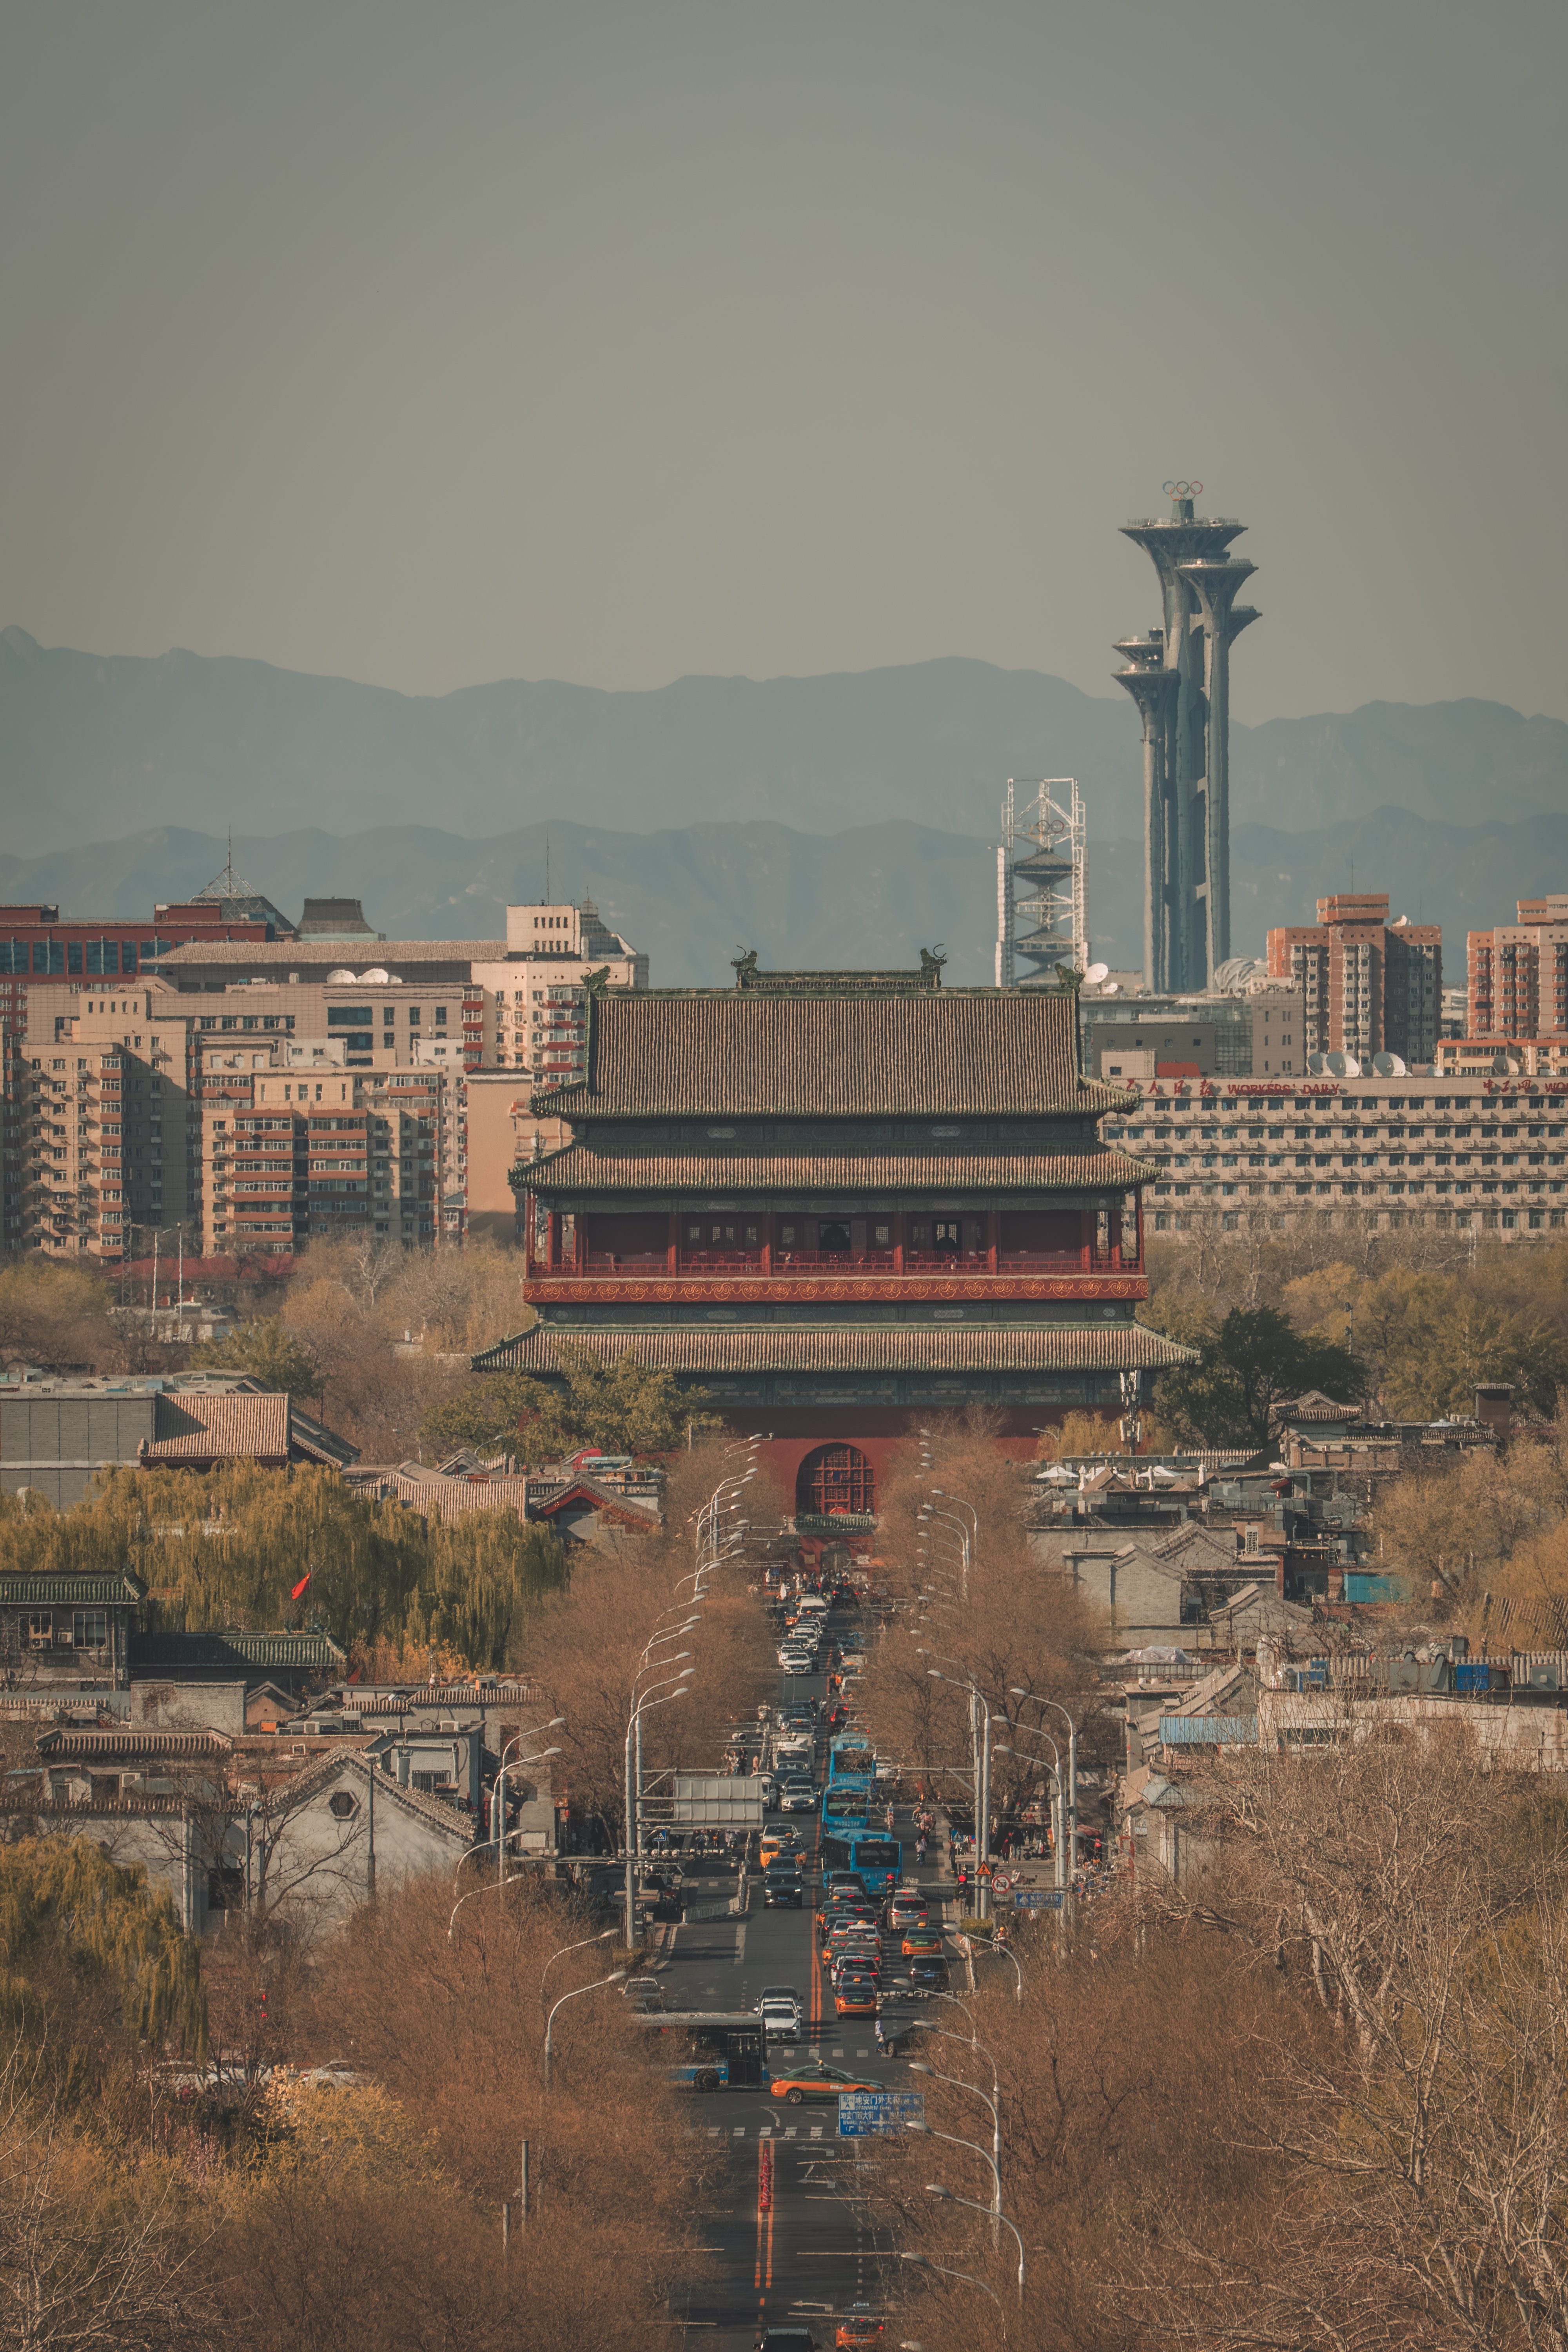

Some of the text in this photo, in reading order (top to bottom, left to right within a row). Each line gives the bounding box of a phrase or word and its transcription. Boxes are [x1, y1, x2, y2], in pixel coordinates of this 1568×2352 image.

[1227, 1084, 1339, 1095] WORKERS' DAILY
[1483, 1079, 1531, 1094] 中工网
